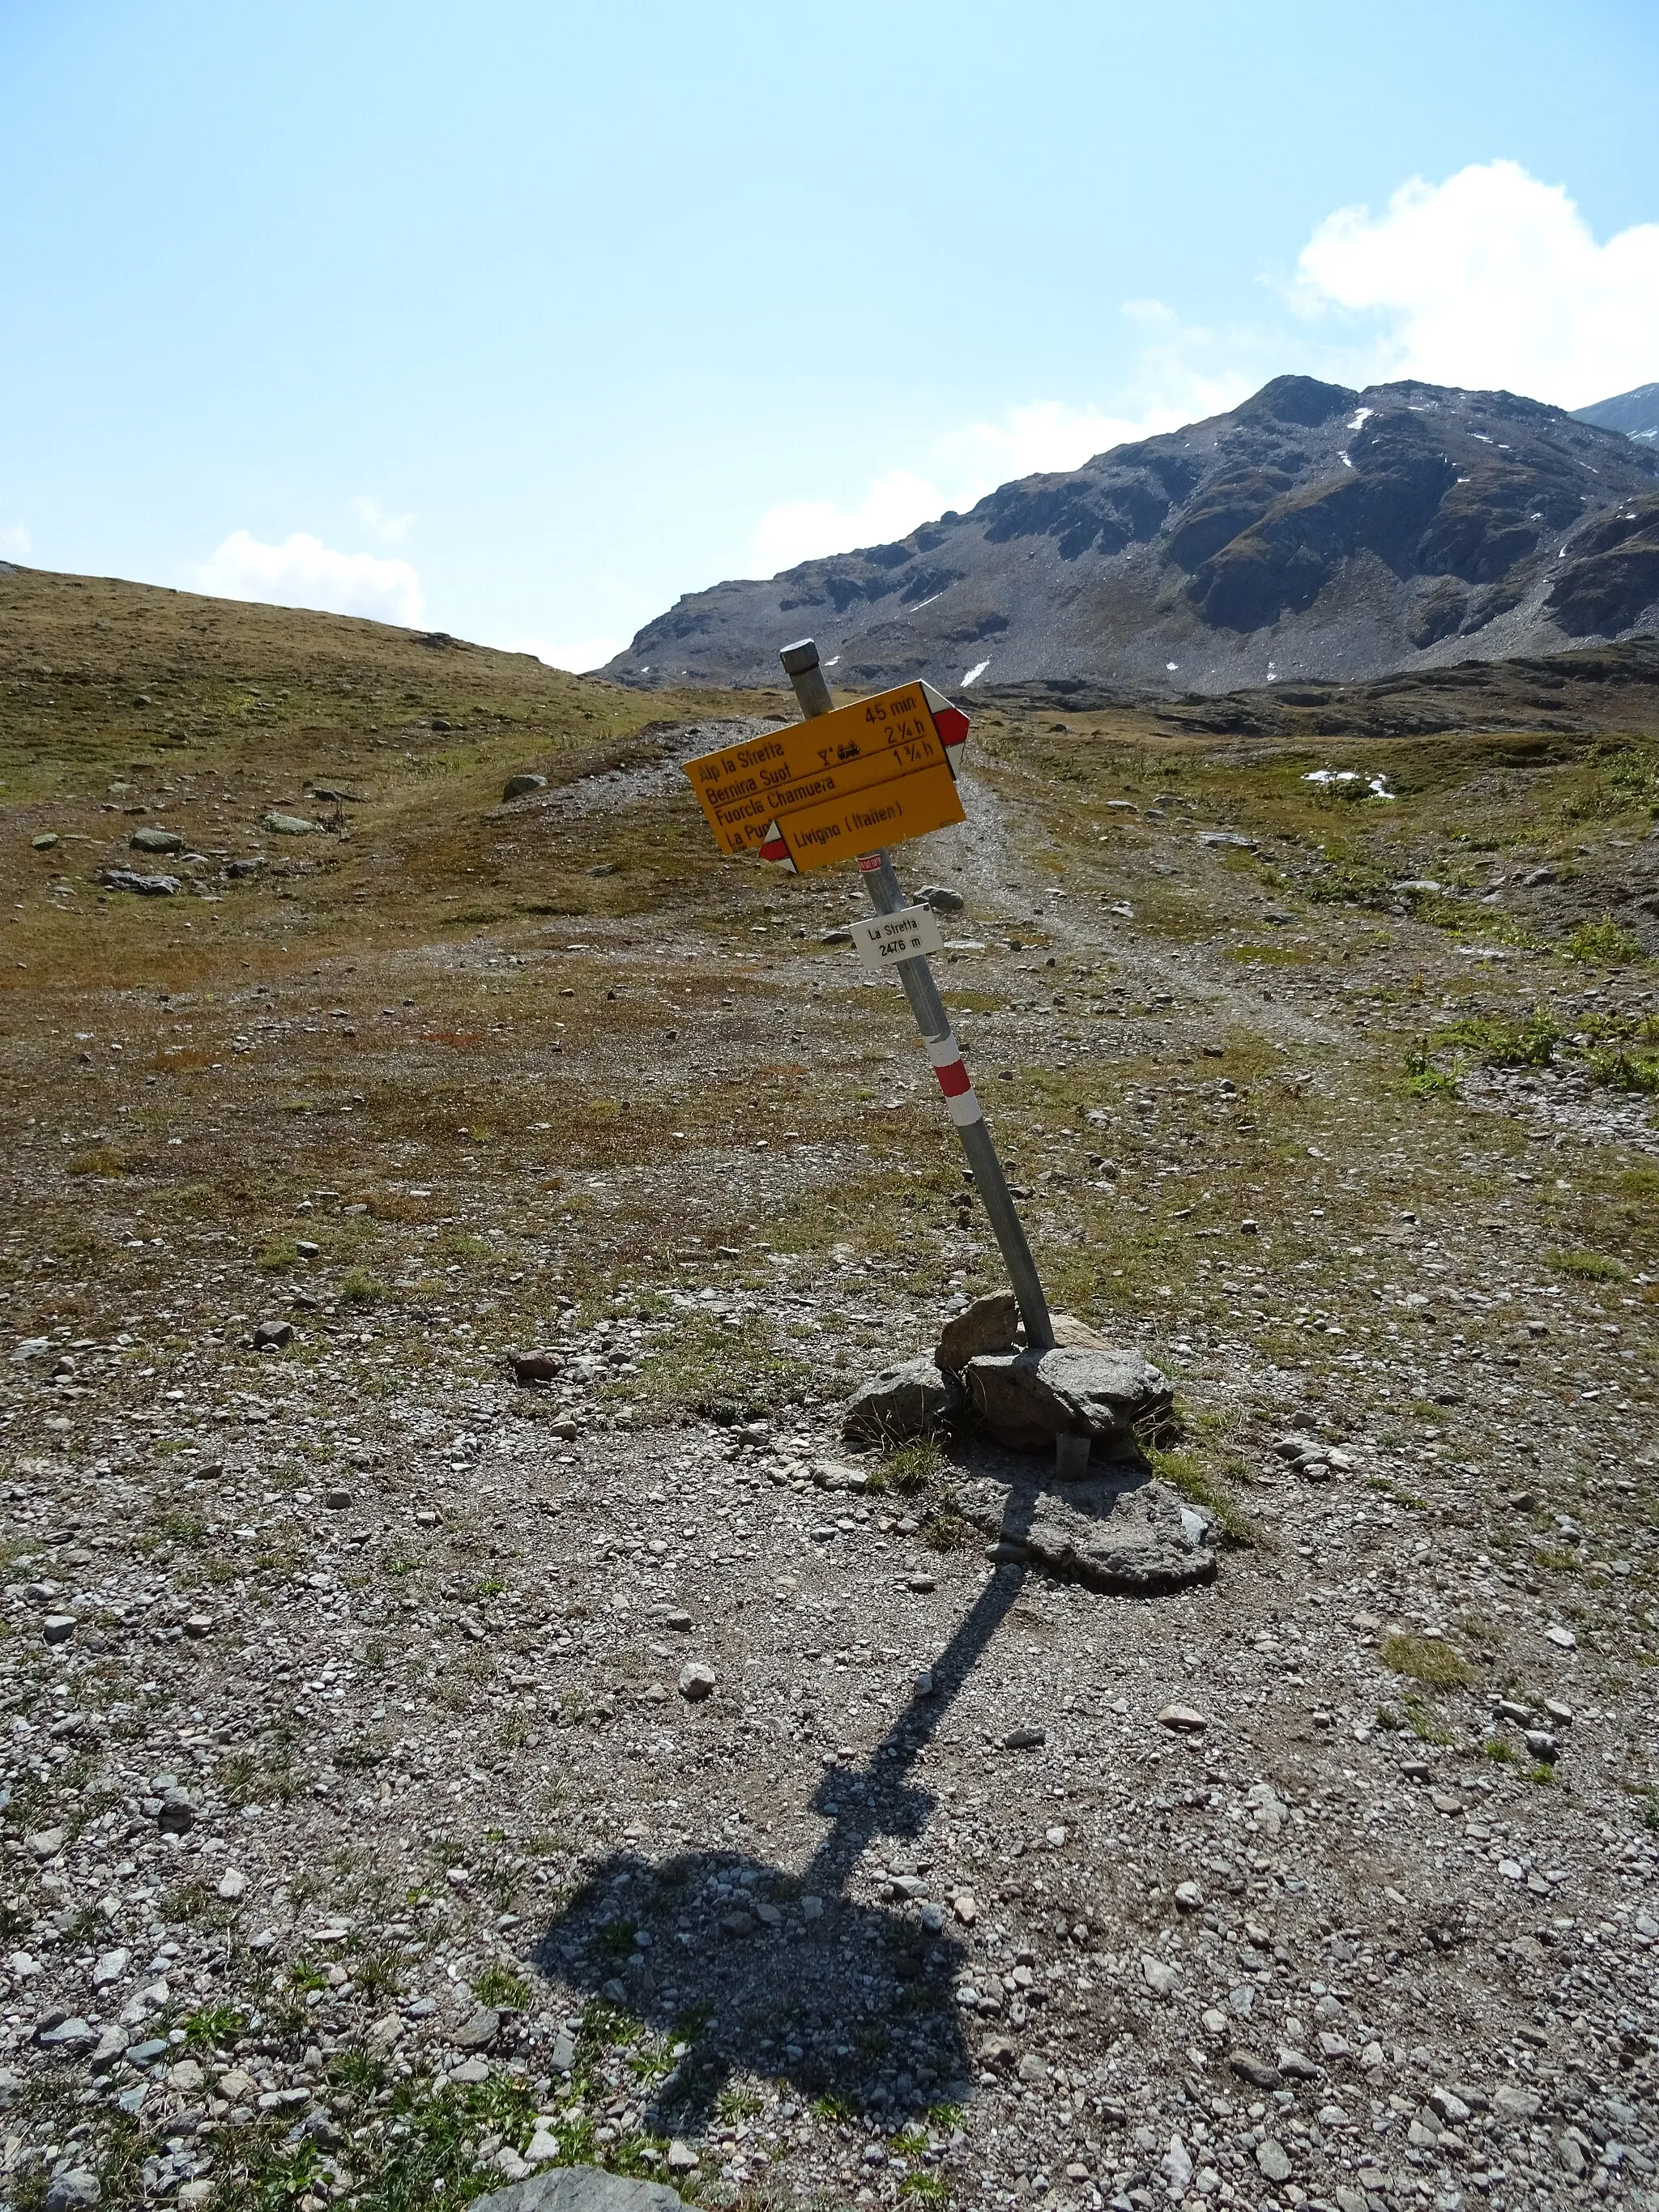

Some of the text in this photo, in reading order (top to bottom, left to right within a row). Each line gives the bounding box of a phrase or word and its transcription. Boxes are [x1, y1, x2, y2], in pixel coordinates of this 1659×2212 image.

[699, 696, 917, 782] Alp la Stretta 45 min
[706, 778, 757, 806] Bernina
[759, 762, 791, 786] Suot
[913, 718, 925, 734] h
[714, 799, 764, 826] Fuorcla
[767, 777, 835, 808] Chamuera
[921, 740, 934, 757] h
[725, 832, 743, 848] La
[792, 824, 841, 849] Livigno
[868, 919, 918, 940] La Stretta
[879, 938, 921, 956] 2476 m
